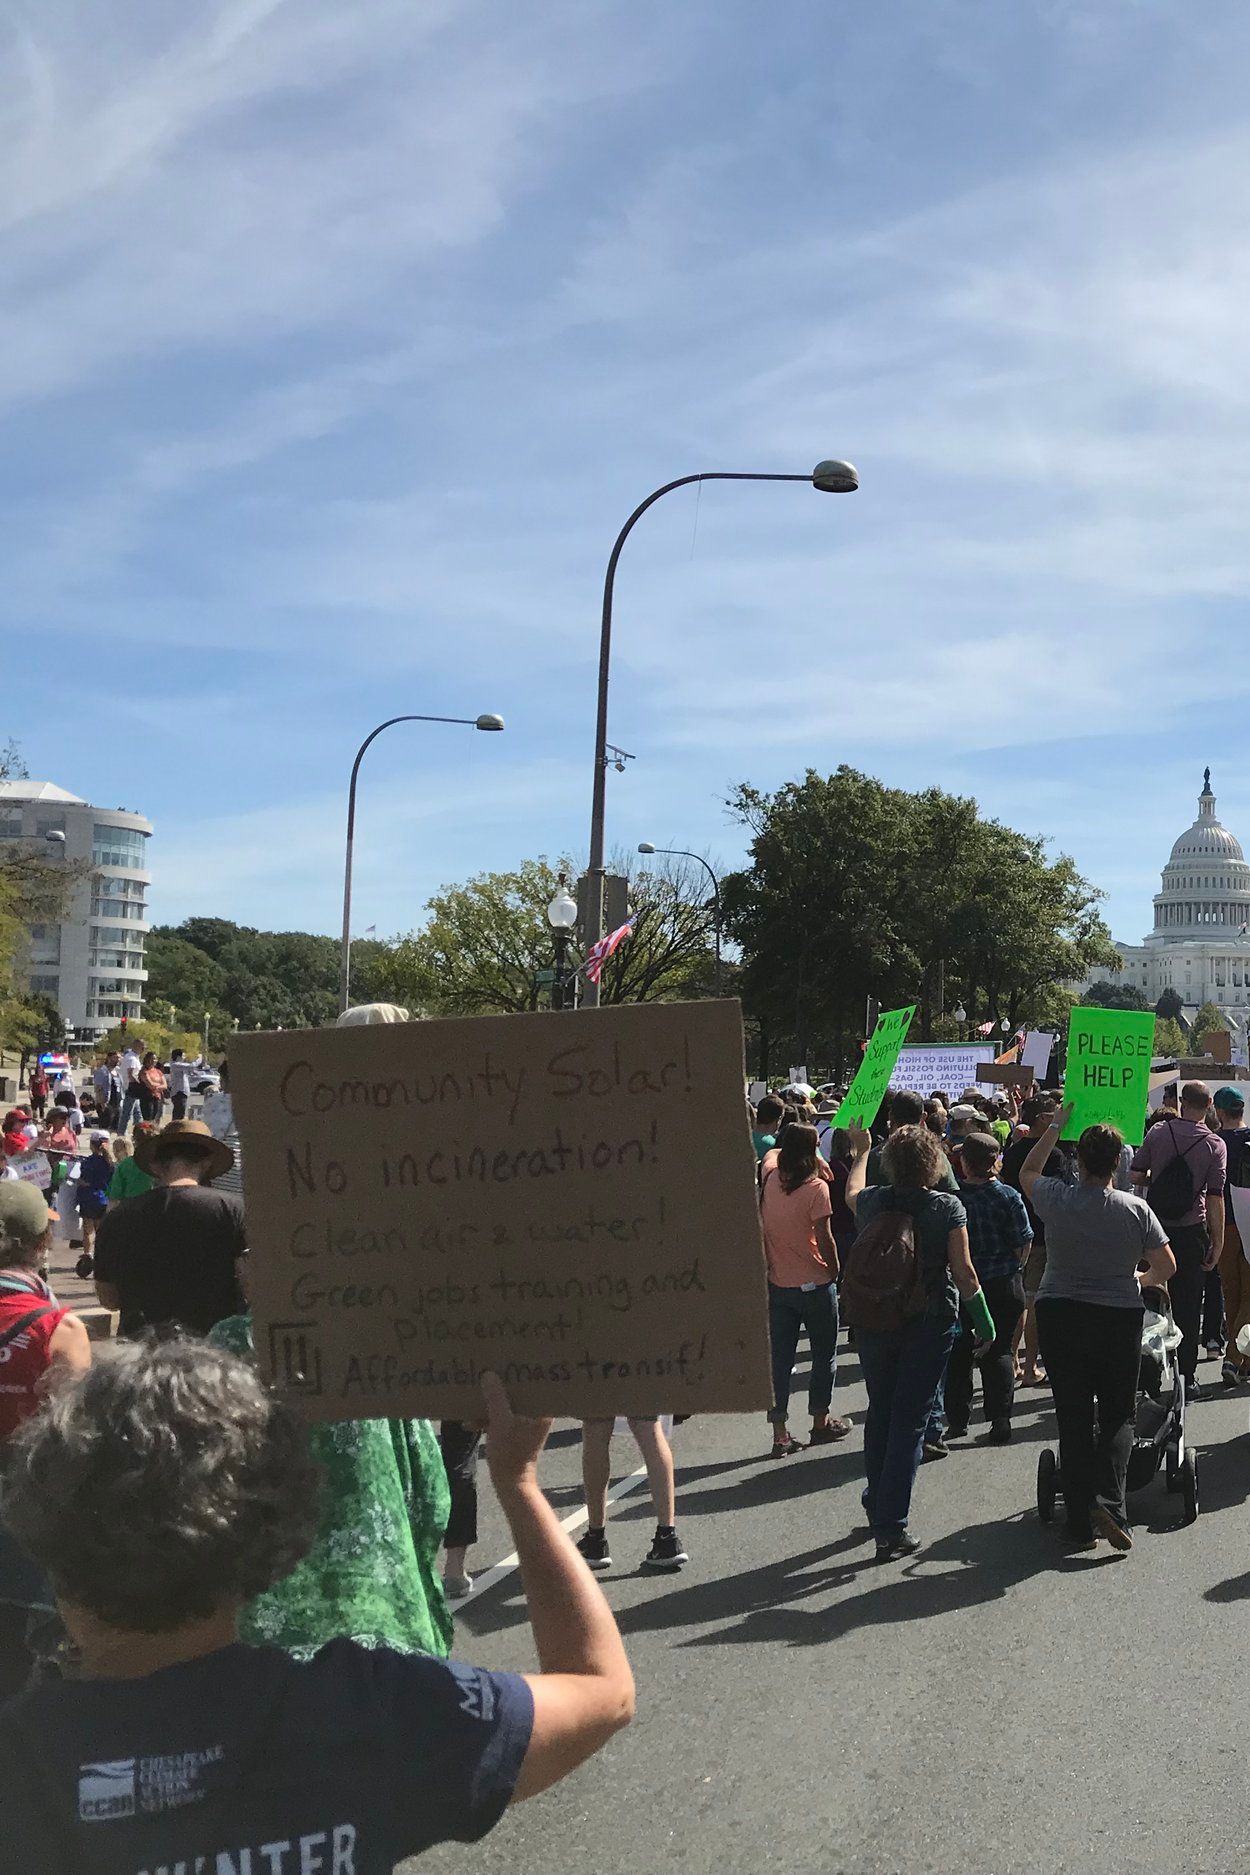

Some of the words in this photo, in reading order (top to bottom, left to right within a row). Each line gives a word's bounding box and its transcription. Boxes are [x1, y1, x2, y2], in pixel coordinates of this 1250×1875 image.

[1078, 1033, 1148, 1056] PLEASE
[280, 1052, 525, 1125] Community
[549, 1034, 693, 1098] Solar!
[1084, 1064, 1133, 1088] HELP
[286, 1142, 348, 1200] No
[382, 1119, 659, 1188] incineration!
[290, 1219, 407, 1258] Clean
[420, 1219, 479, 1254] air
[290, 1271, 398, 1312] Green
[413, 1276, 481, 1316] jobs
[489, 1270, 632, 1313] training
[641, 1257, 706, 1293] and
[503, 1357, 571, 1385] mass
